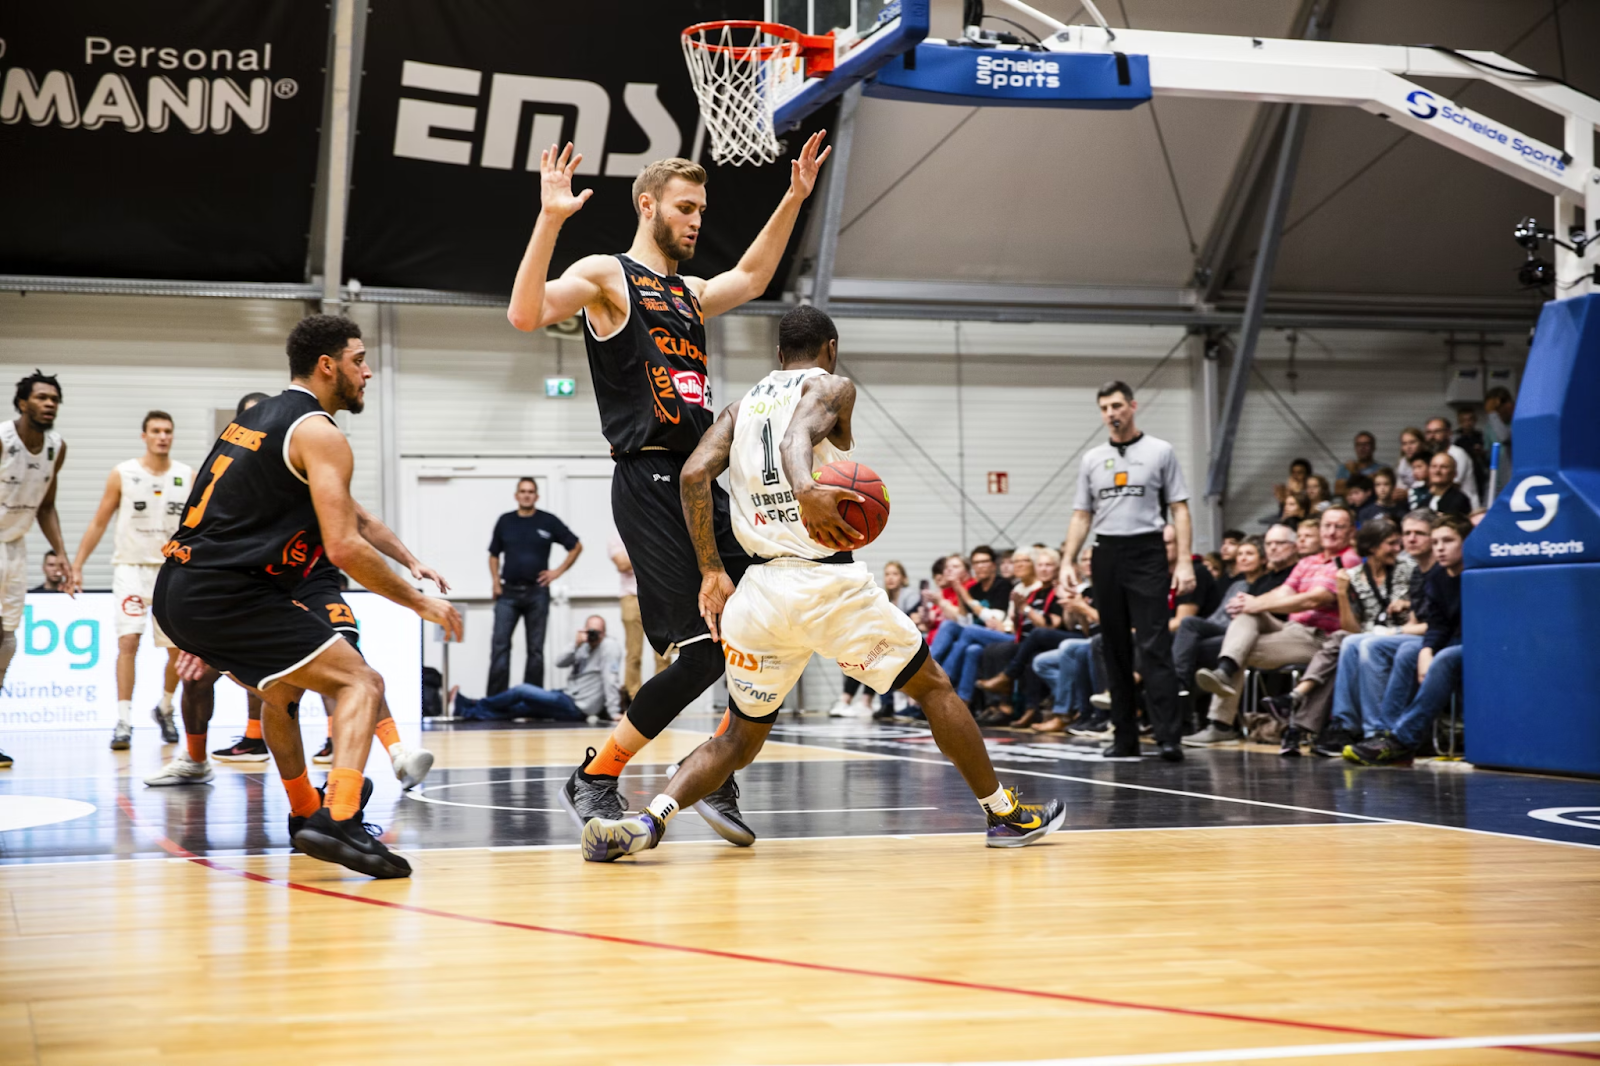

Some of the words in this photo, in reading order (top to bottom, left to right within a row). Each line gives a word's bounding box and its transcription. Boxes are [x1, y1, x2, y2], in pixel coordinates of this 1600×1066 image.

[85, 36, 272, 71] Personal
[975, 70, 1061, 89] Sports
[1511, 138, 1566, 171] Sports
[652, 366, 676, 399] SDV
[760, 418, 780, 485] 1
[1540, 539, 1585, 558] Sports
[0, 681, 97, 702] Nürnberg
